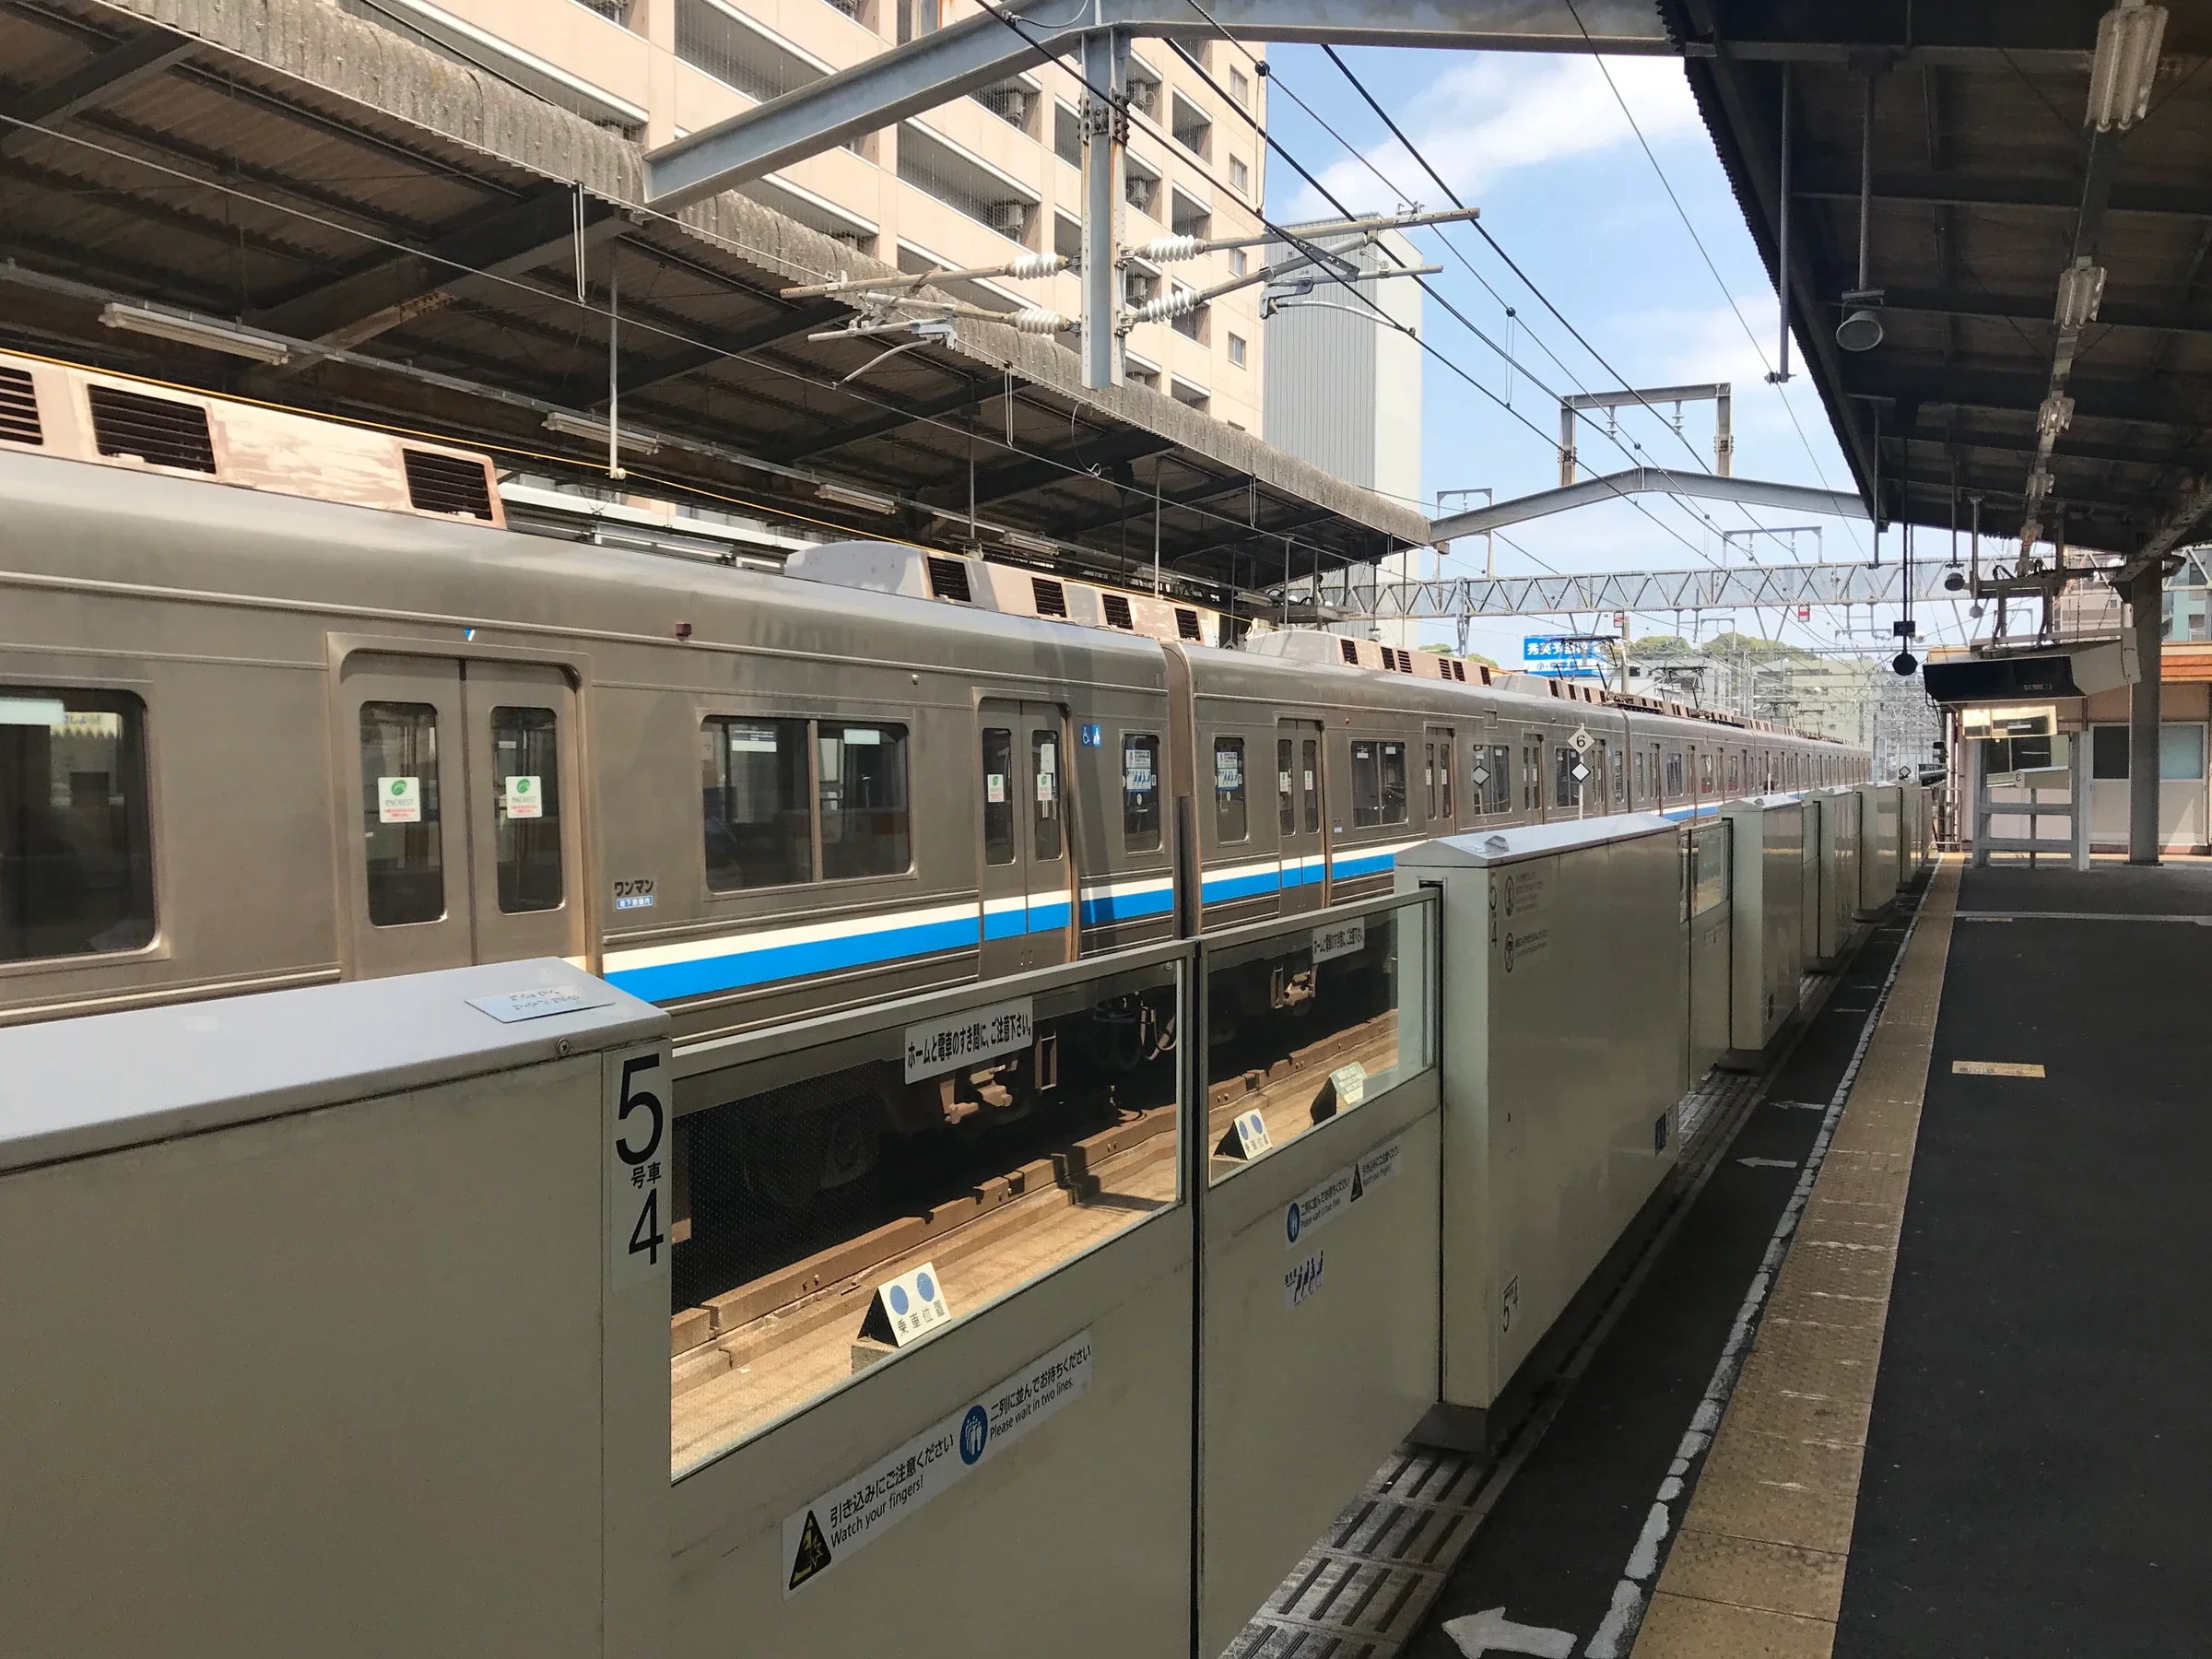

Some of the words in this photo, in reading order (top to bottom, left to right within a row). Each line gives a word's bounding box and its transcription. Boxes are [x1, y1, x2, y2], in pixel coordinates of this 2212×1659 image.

[1576, 735, 1586, 747] 6
[615, 879, 653, 897] ワンマン
[1491, 921, 1498, 948] 4
[908, 1012, 1031, 1069] ホームと電車のすき間に、ご注意下さい。
[616, 1053, 664, 1166] 5
[630, 1161, 662, 1189] 号車
[628, 1187, 665, 1265] 4
[990, 1345, 1091, 1422] 二列に並んでお待ちください
[990, 1417, 1014, 1441] Please
[1015, 1402, 1031, 1424] wait
[1032, 1398, 1041, 1412] in
[1041, 1389, 1056, 1406] two
[830, 1433, 954, 1529] 引き込みにご注意ください
[830, 1516, 864, 1548] Watch
[865, 1501, 888, 1530] your
[889, 1475, 924, 1510] fingers!
